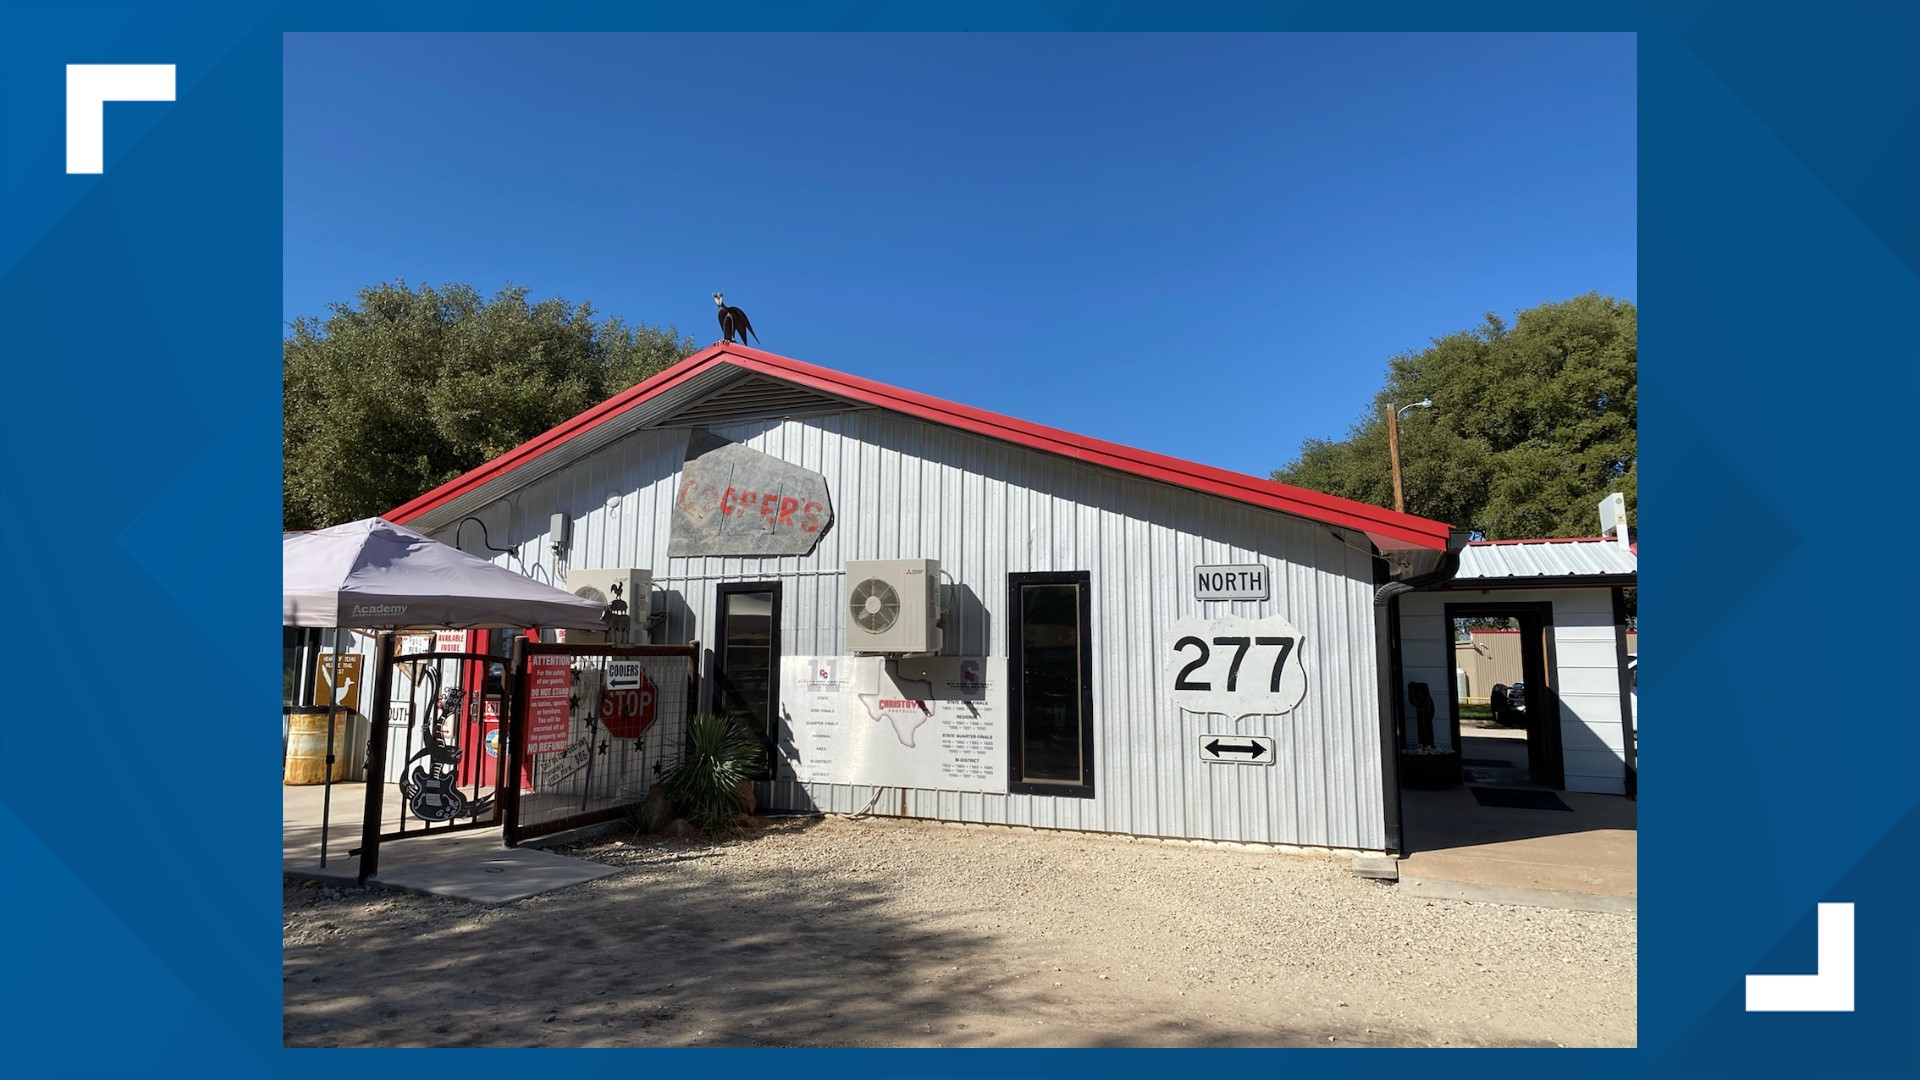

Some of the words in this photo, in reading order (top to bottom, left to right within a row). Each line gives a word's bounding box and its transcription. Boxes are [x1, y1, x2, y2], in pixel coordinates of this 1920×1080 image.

[678, 479, 824, 533] COOPER'S
[1198, 572, 1262, 591] NORTH
[352, 604, 408, 614] Academy
[437, 634, 464, 643] AVAILABLE
[441, 643, 460, 652] INSIDE
[532, 655, 570, 666] ATTENTION
[1173, 636, 1295, 693] 277
[553, 669, 565, 677] safety
[609, 664, 639, 677] COOLERS
[807, 660, 840, 692] 11
[960, 660, 979, 695] 6
[531, 688, 539, 696] DO
[540, 688, 551, 696] NOT
[552, 687, 569, 696] STAND
[602, 690, 652, 717] STOP
[388, 707, 410, 721] OUTH
[527, 743, 537, 753] NO
[539, 741, 567, 751] REFUND!
